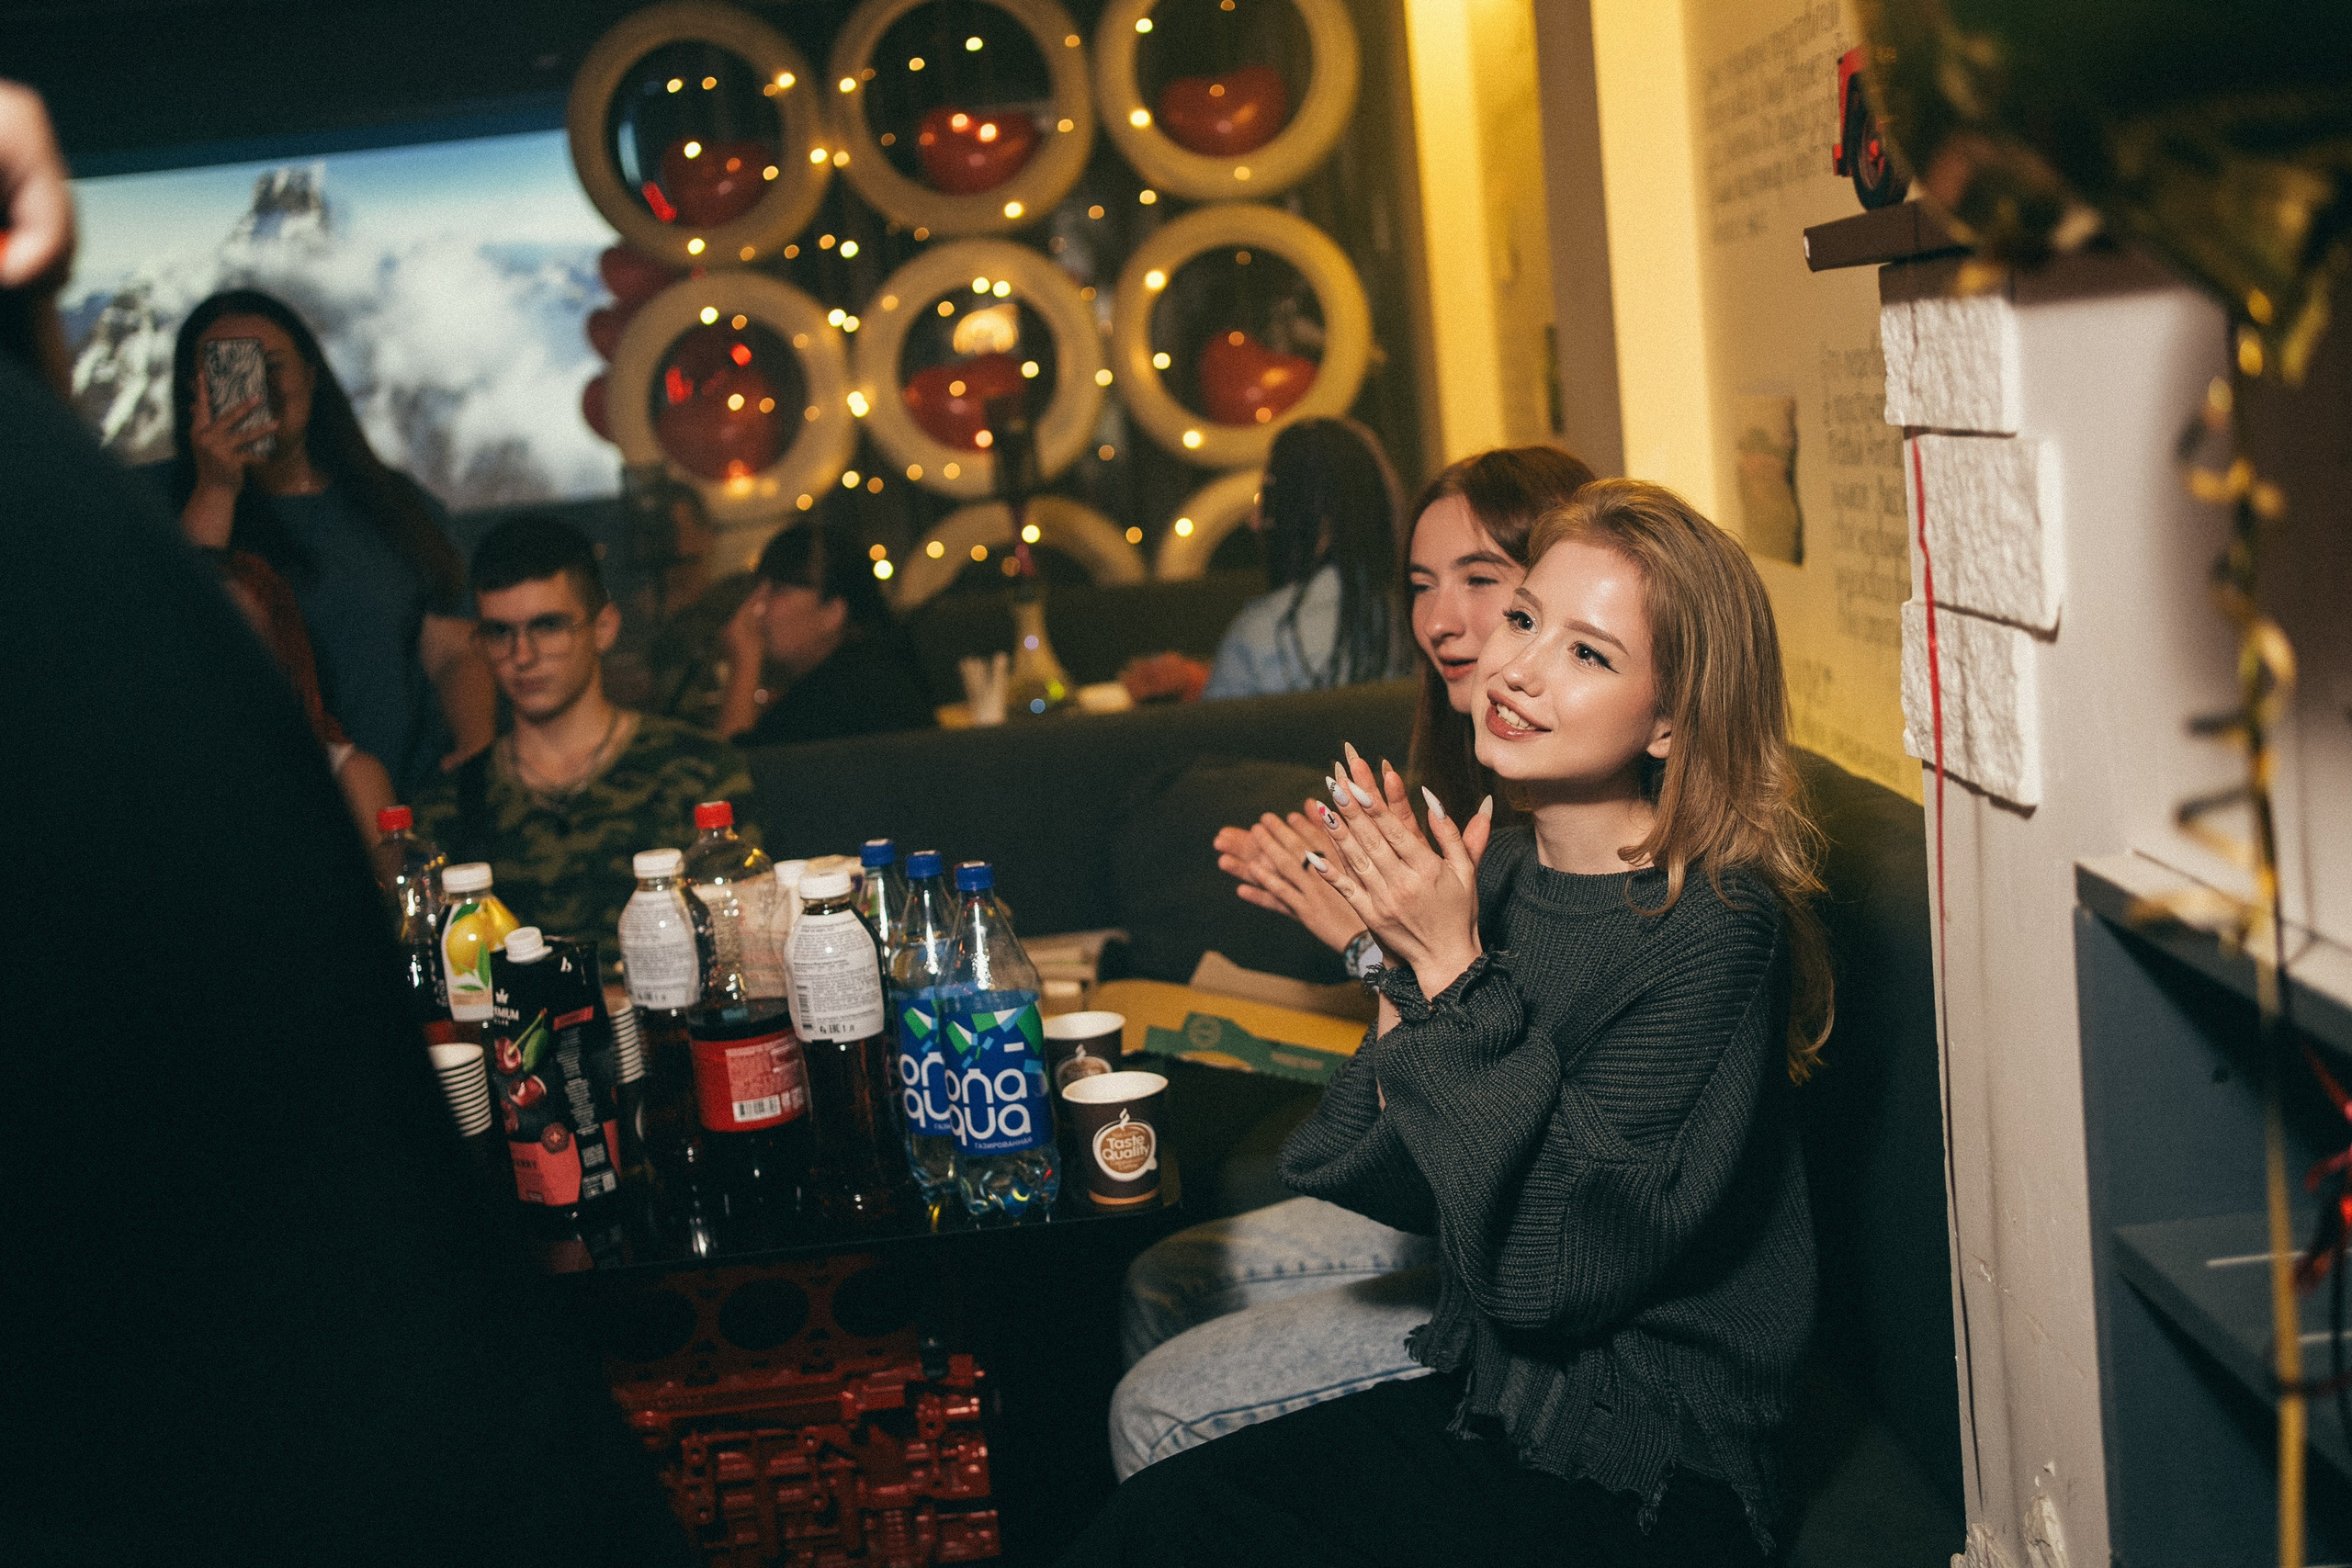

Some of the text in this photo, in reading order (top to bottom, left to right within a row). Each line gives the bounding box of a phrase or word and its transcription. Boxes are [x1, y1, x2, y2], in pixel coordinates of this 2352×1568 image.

[492, 1006, 519, 1021] EMIUM
[903, 1088, 951, 1128] qu
[1106, 1134, 1145, 1150] Taste
[1102, 1145, 1148, 1161] Quality
